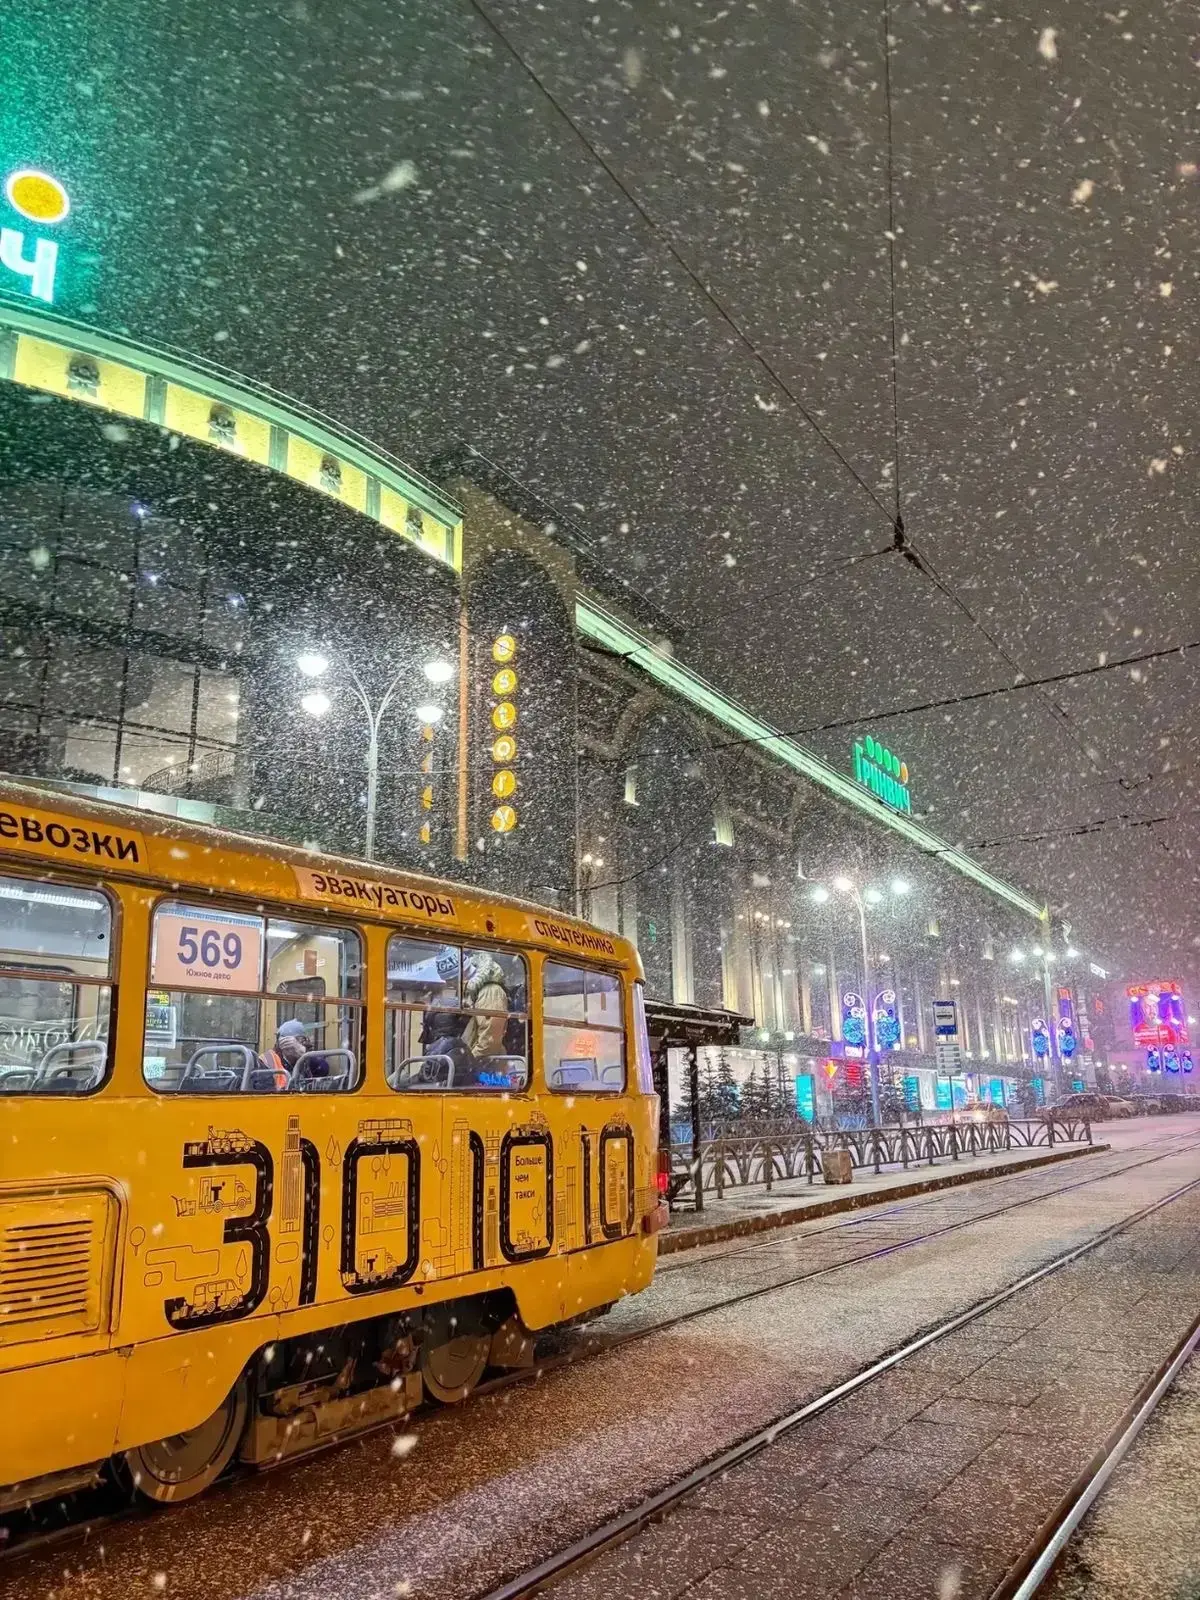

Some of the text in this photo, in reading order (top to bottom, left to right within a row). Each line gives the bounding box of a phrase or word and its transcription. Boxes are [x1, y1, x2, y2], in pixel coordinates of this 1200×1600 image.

[312, 873, 455, 916] эвакуаторы
[177, 926, 242, 970] 569
[535, 919, 615, 955] спецтехника
[186, 968, 212, 979] Южное
[515, 1174, 529, 1183] чем
[515, 1189, 536, 1200] такси
